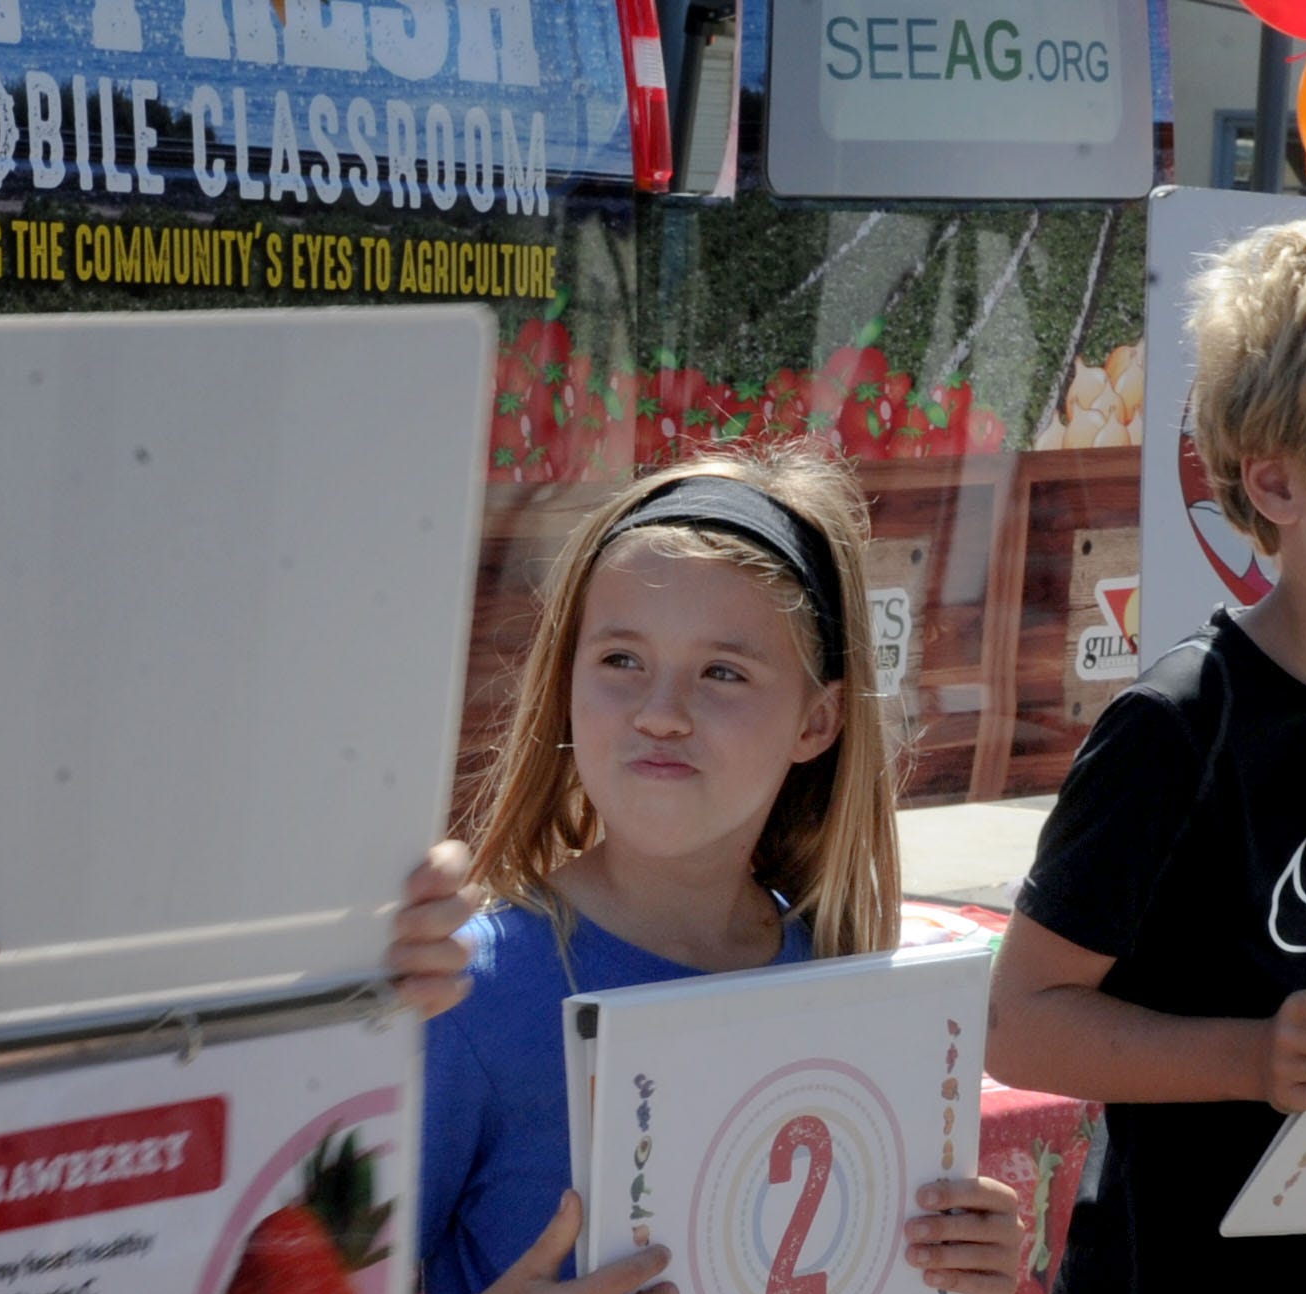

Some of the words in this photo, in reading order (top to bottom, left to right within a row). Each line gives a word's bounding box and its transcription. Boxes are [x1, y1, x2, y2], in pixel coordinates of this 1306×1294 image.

[826, 16, 1110, 83] SEEAG.ORG
[192, 83, 550, 217] CLASSROOM
[11, 219, 66, 281] THE
[75, 222, 284, 289] COMMUNITY'S
[292, 232, 353, 290] EYES
[361, 236, 392, 292] TO
[399, 239, 558, 299] AGRICULTURE
